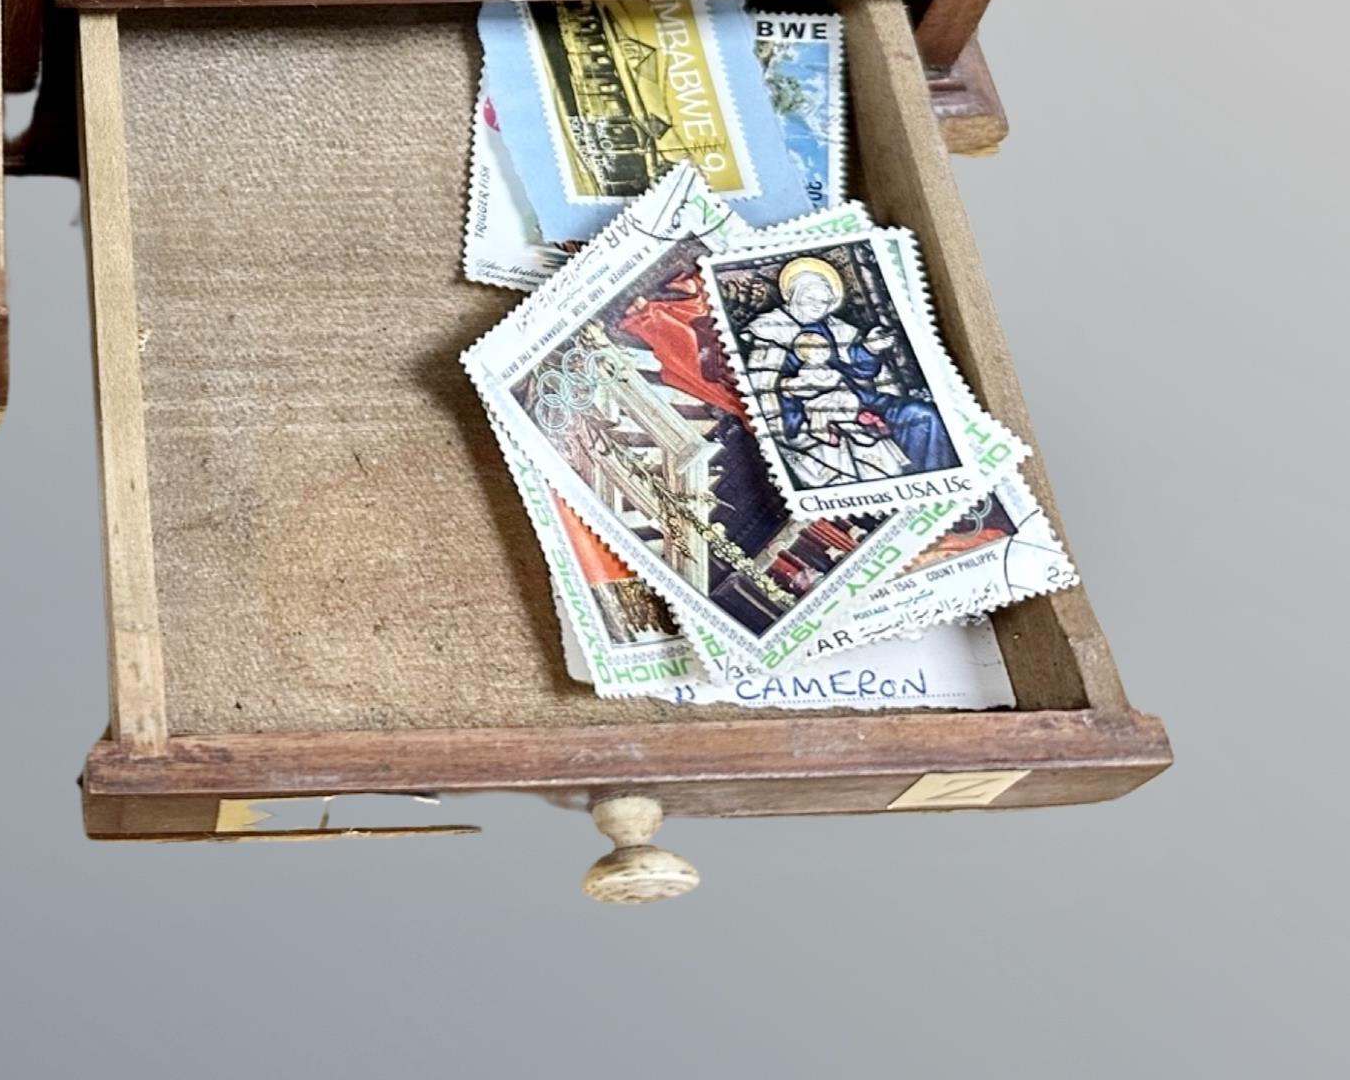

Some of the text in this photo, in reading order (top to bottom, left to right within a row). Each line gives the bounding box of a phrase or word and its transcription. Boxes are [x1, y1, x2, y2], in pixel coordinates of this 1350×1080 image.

[756, 19, 830, 40] BWE
[474, 165, 490, 240] TRIGGER FISH
[799, 477, 973, 513] Christmas USA 15c
[847, 546, 902, 597] CITY
[925, 565, 956, 581] COUNT
[957, 550, 999, 573] PHILIPPE
[550, 547, 611, 684] OLYMPIC
[761, 618, 822, 670] 1972
[806, 628, 853, 655] AR
[735, 669, 928, 700] CAMERON
[925, 777, 1003, 801] Z
